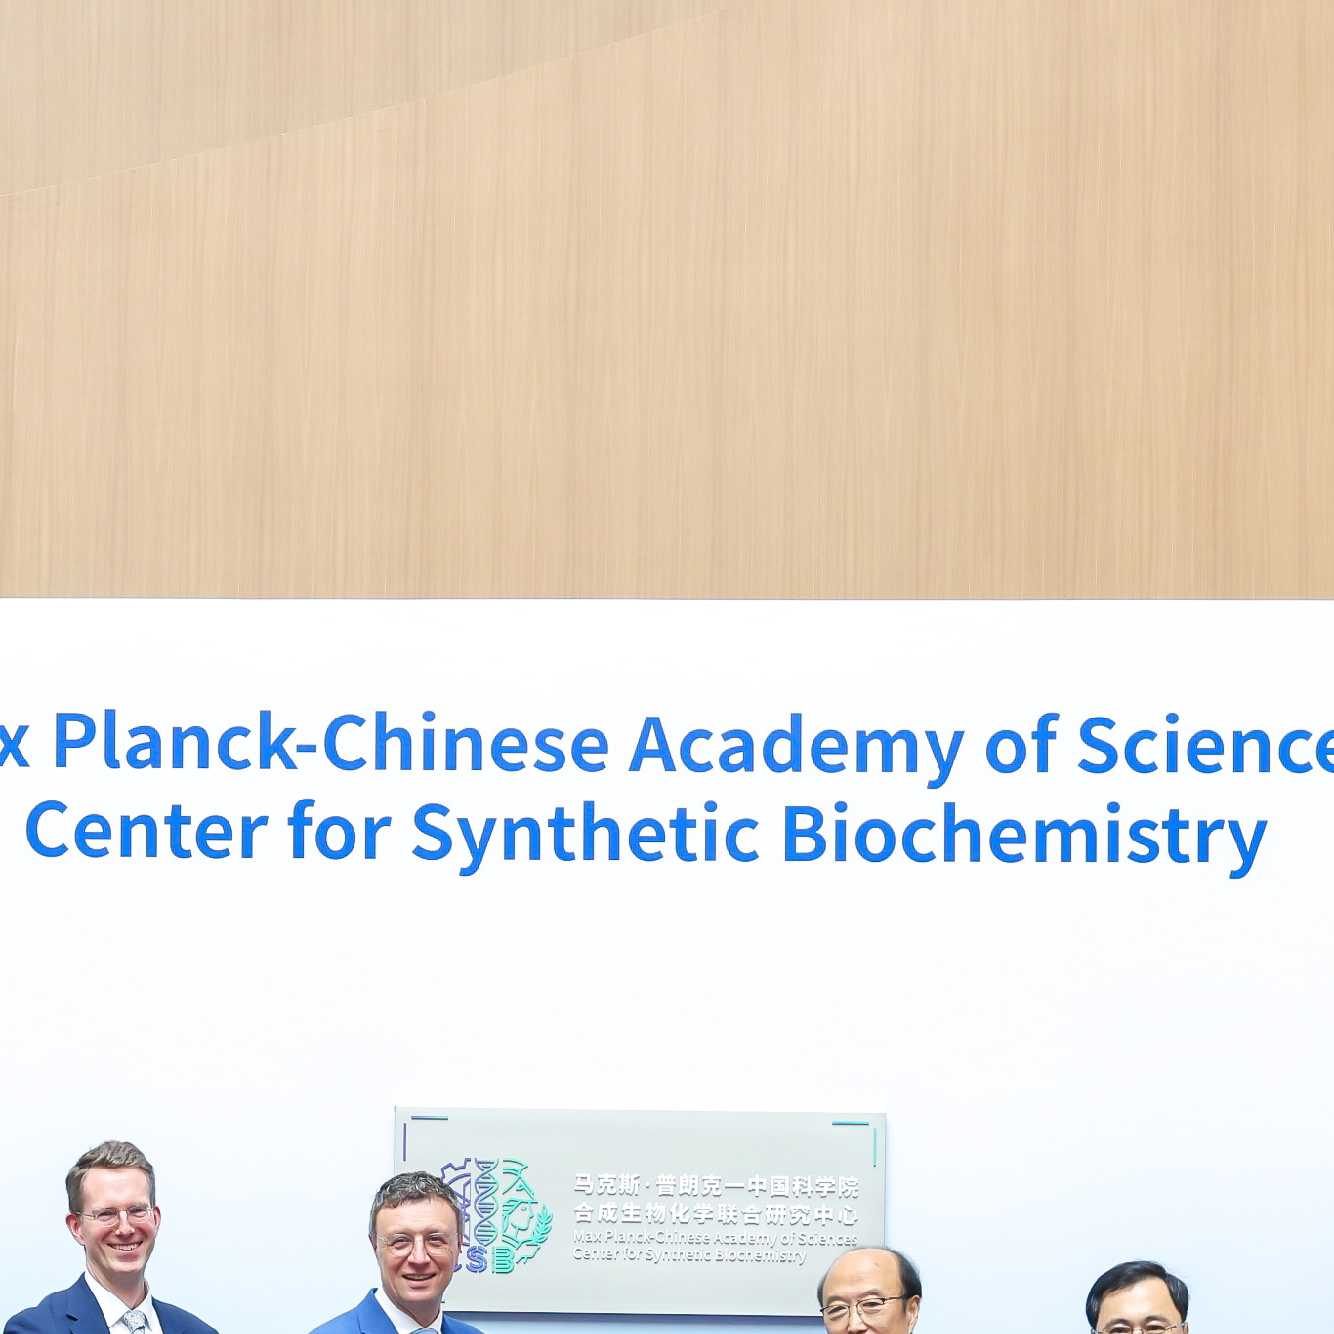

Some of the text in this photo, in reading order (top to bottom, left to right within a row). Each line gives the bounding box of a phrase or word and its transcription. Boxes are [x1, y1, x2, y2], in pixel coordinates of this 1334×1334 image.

[55, 709, 609, 772] Planck-Chinese
[628, 713, 965, 789] Academy
[985, 712, 1061, 774] of
[25, 799, 1269, 879] Center for Synthetic Biochemistry
[573, 1202, 859, 1226] 合成生物化学联合研究中心
[573, 1229, 858, 1249] Max Planck-Chinese Academy of Sciences
[573, 1247, 807, 1266] Center for Synthetic Biochemistry
